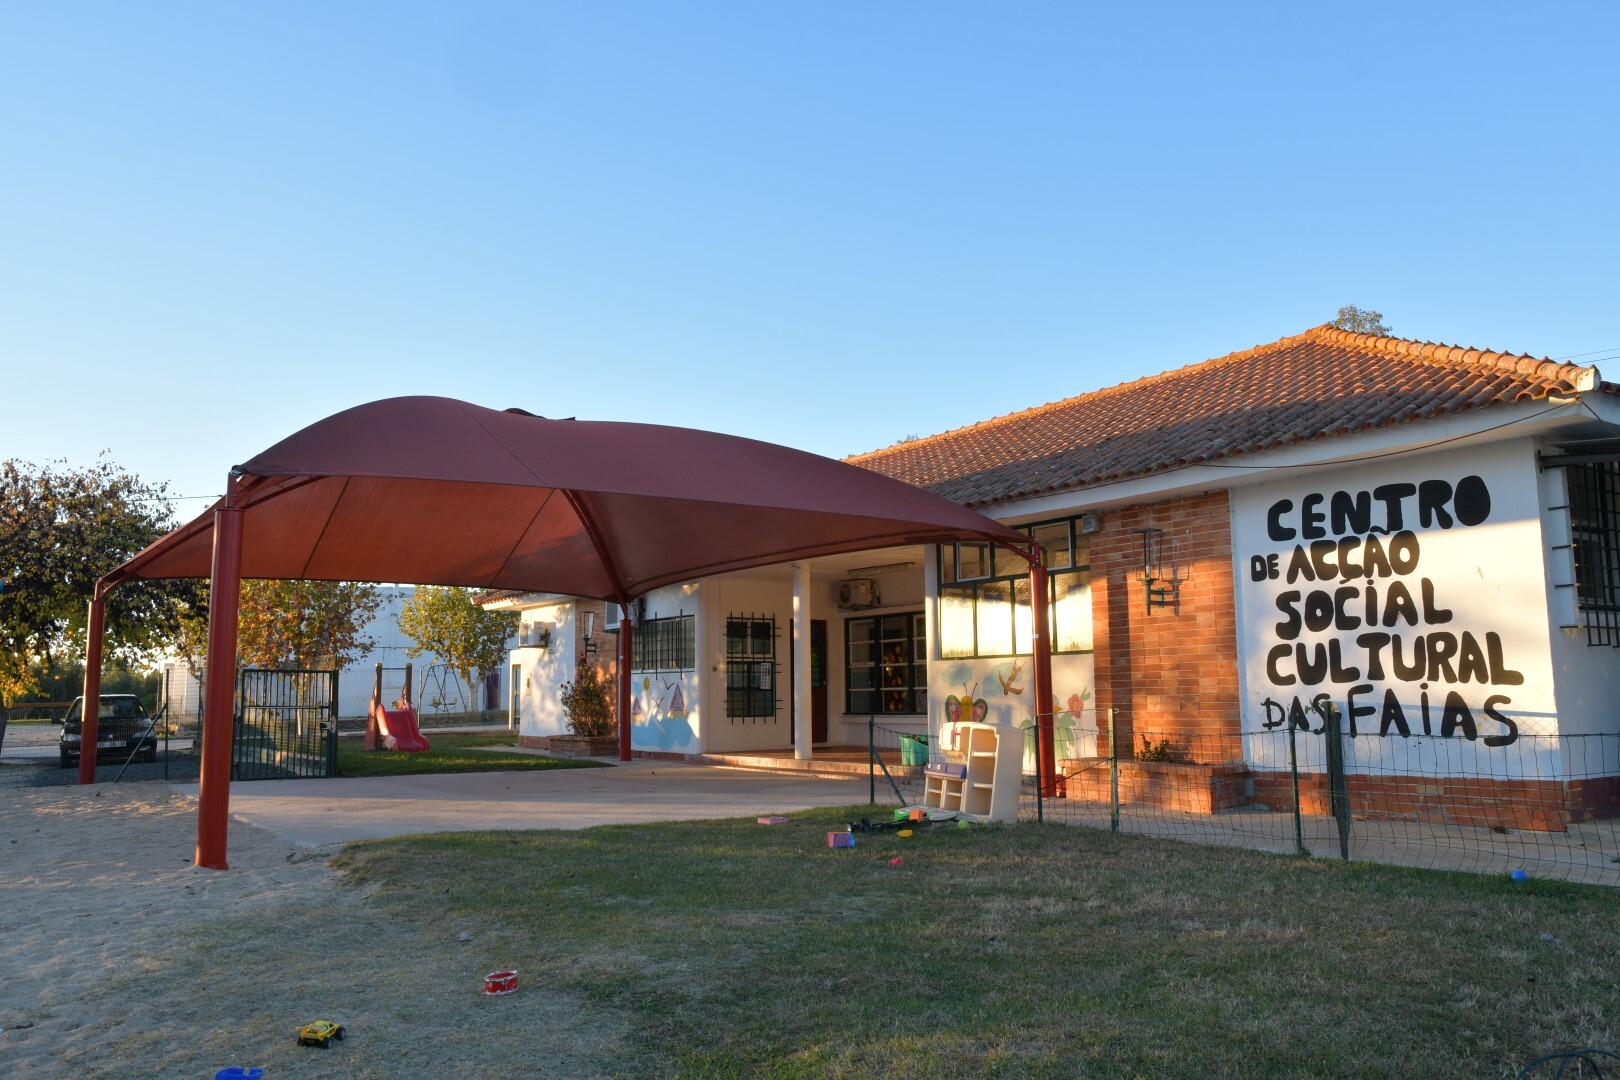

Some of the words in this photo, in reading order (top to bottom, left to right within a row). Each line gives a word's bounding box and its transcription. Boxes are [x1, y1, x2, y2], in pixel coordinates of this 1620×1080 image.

[1267, 475, 1491, 541] CENTRO
[1250, 553, 1279, 582] DE
[1286, 525, 1420, 584] ACÇÃO
[1266, 631, 1525, 686] CULTURAL
[1261, 693, 1330, 735] DAS
